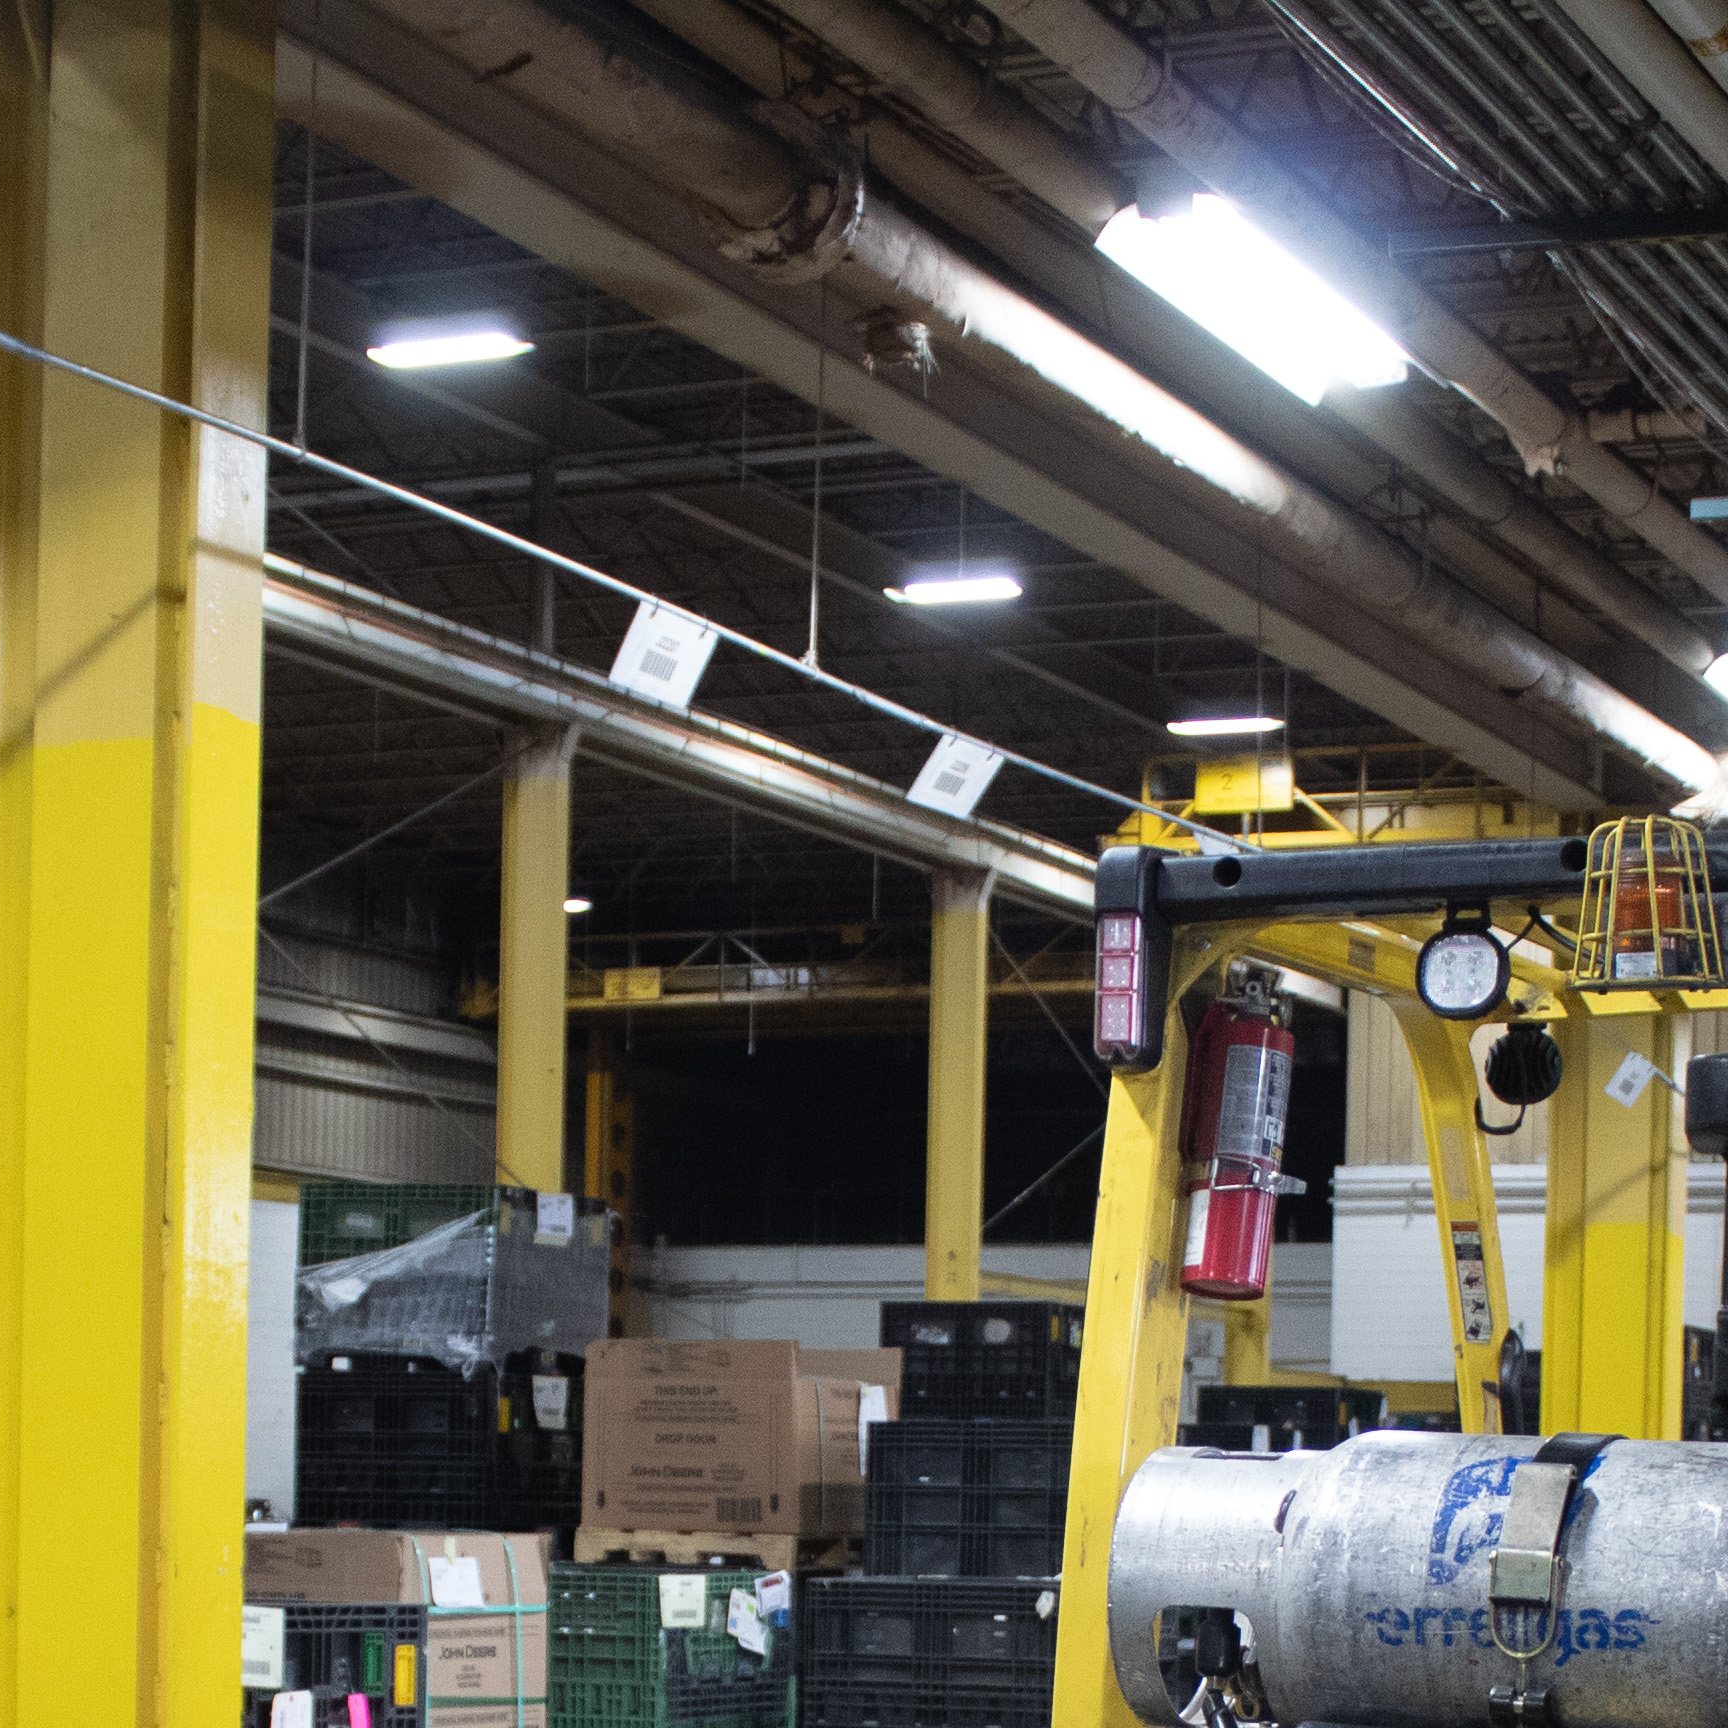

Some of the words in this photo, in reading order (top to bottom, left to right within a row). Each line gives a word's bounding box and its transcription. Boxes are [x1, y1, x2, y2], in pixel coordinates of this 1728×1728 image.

[1221, 773, 1232, 790] 2
[654, 1384, 676, 1397] THIS
[678, 1384, 700, 1397] END
[702, 1384, 718, 1397] UP
[627, 1465, 661, 1479] JOHN
[663, 1465, 704, 1479] DEERE
[438, 1645, 464, 1660] JOHN
[465, 1645, 497, 1659] DEERE
